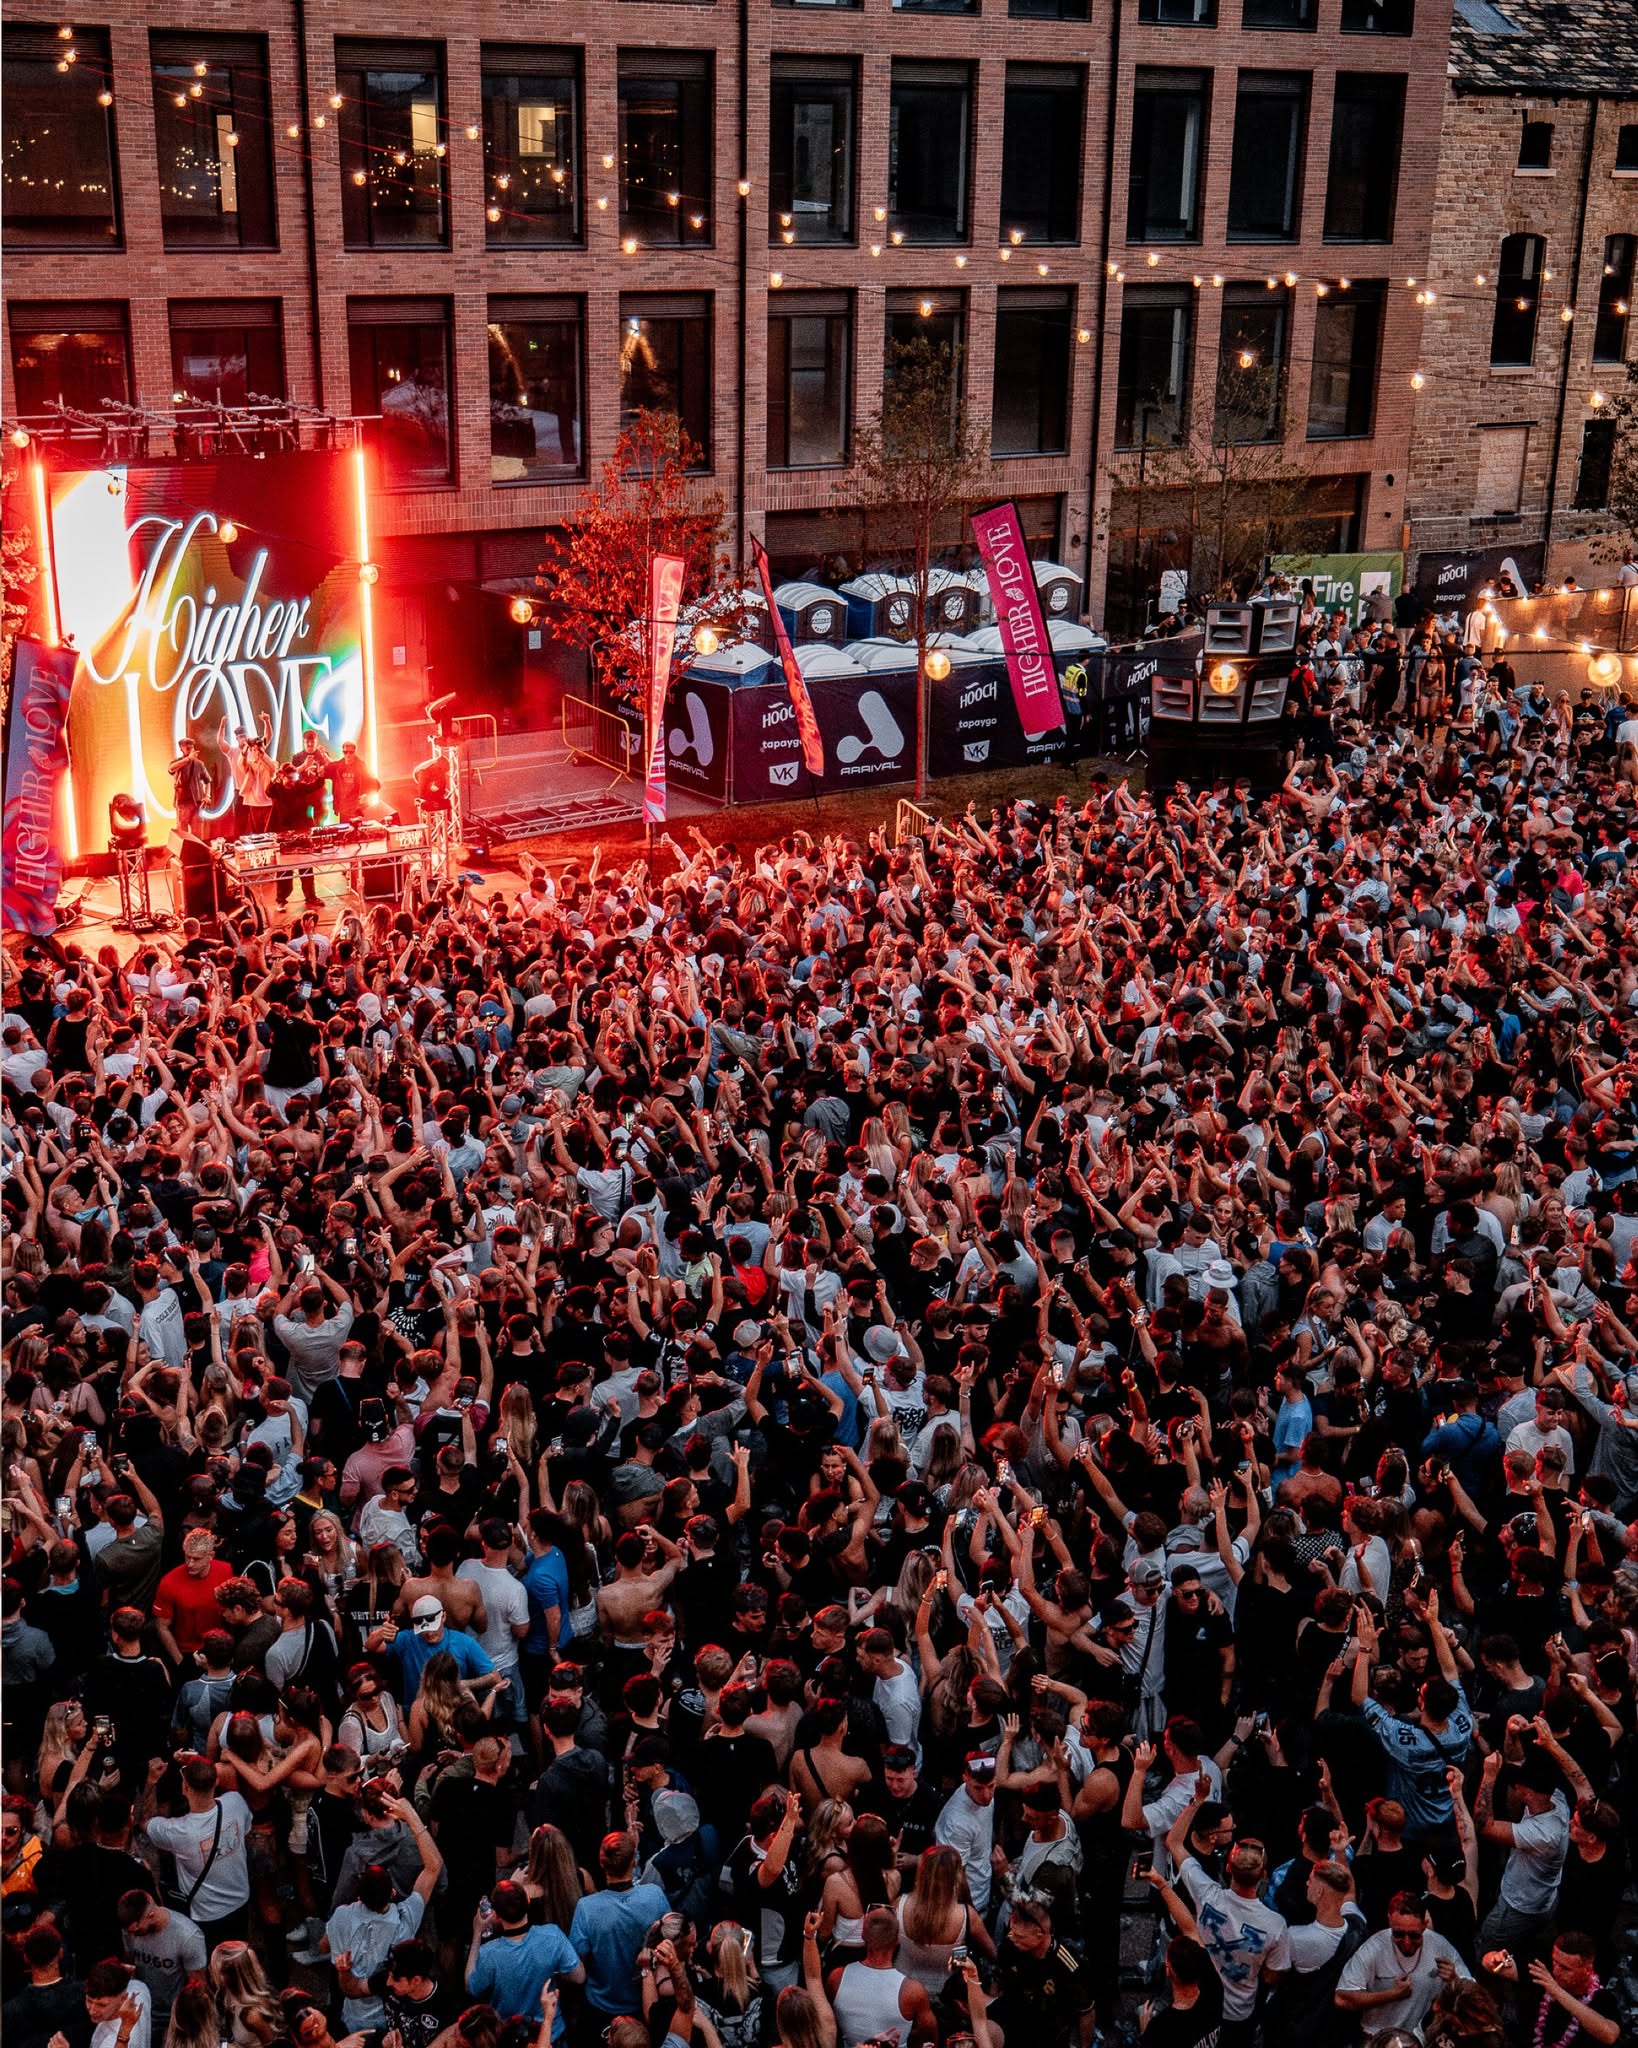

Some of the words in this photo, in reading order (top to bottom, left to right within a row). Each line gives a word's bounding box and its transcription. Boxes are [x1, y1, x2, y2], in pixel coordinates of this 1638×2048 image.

[987, 522, 1023, 588] LOVE
[1313, 575, 1354, 602] Fire
[1438, 565, 1467, 586] HOOCH
[82, 511, 311, 720] Higher
[1008, 600, 1049, 698] HIGHER
[1127, 659, 1158, 688] HOOCH
[25, 666, 59, 747] LOVE
[960, 681, 997, 709] HOOCH
[618, 703, 644, 720] tapayg
[762, 702, 796, 728] HOOC
[959, 717, 998, 729] tapaygo
[123, 656, 334, 824] LOVE
[966, 745, 985, 758] VK
[1027, 741, 1066, 754] ARRIV
[669, 760, 709, 780] ARRIVAL
[773, 766, 794, 781] VK
[840, 761, 901, 776] ARRIVAL
[15, 770, 54, 892] HIGHER
[351, 1611, 374, 1621] WHIT
